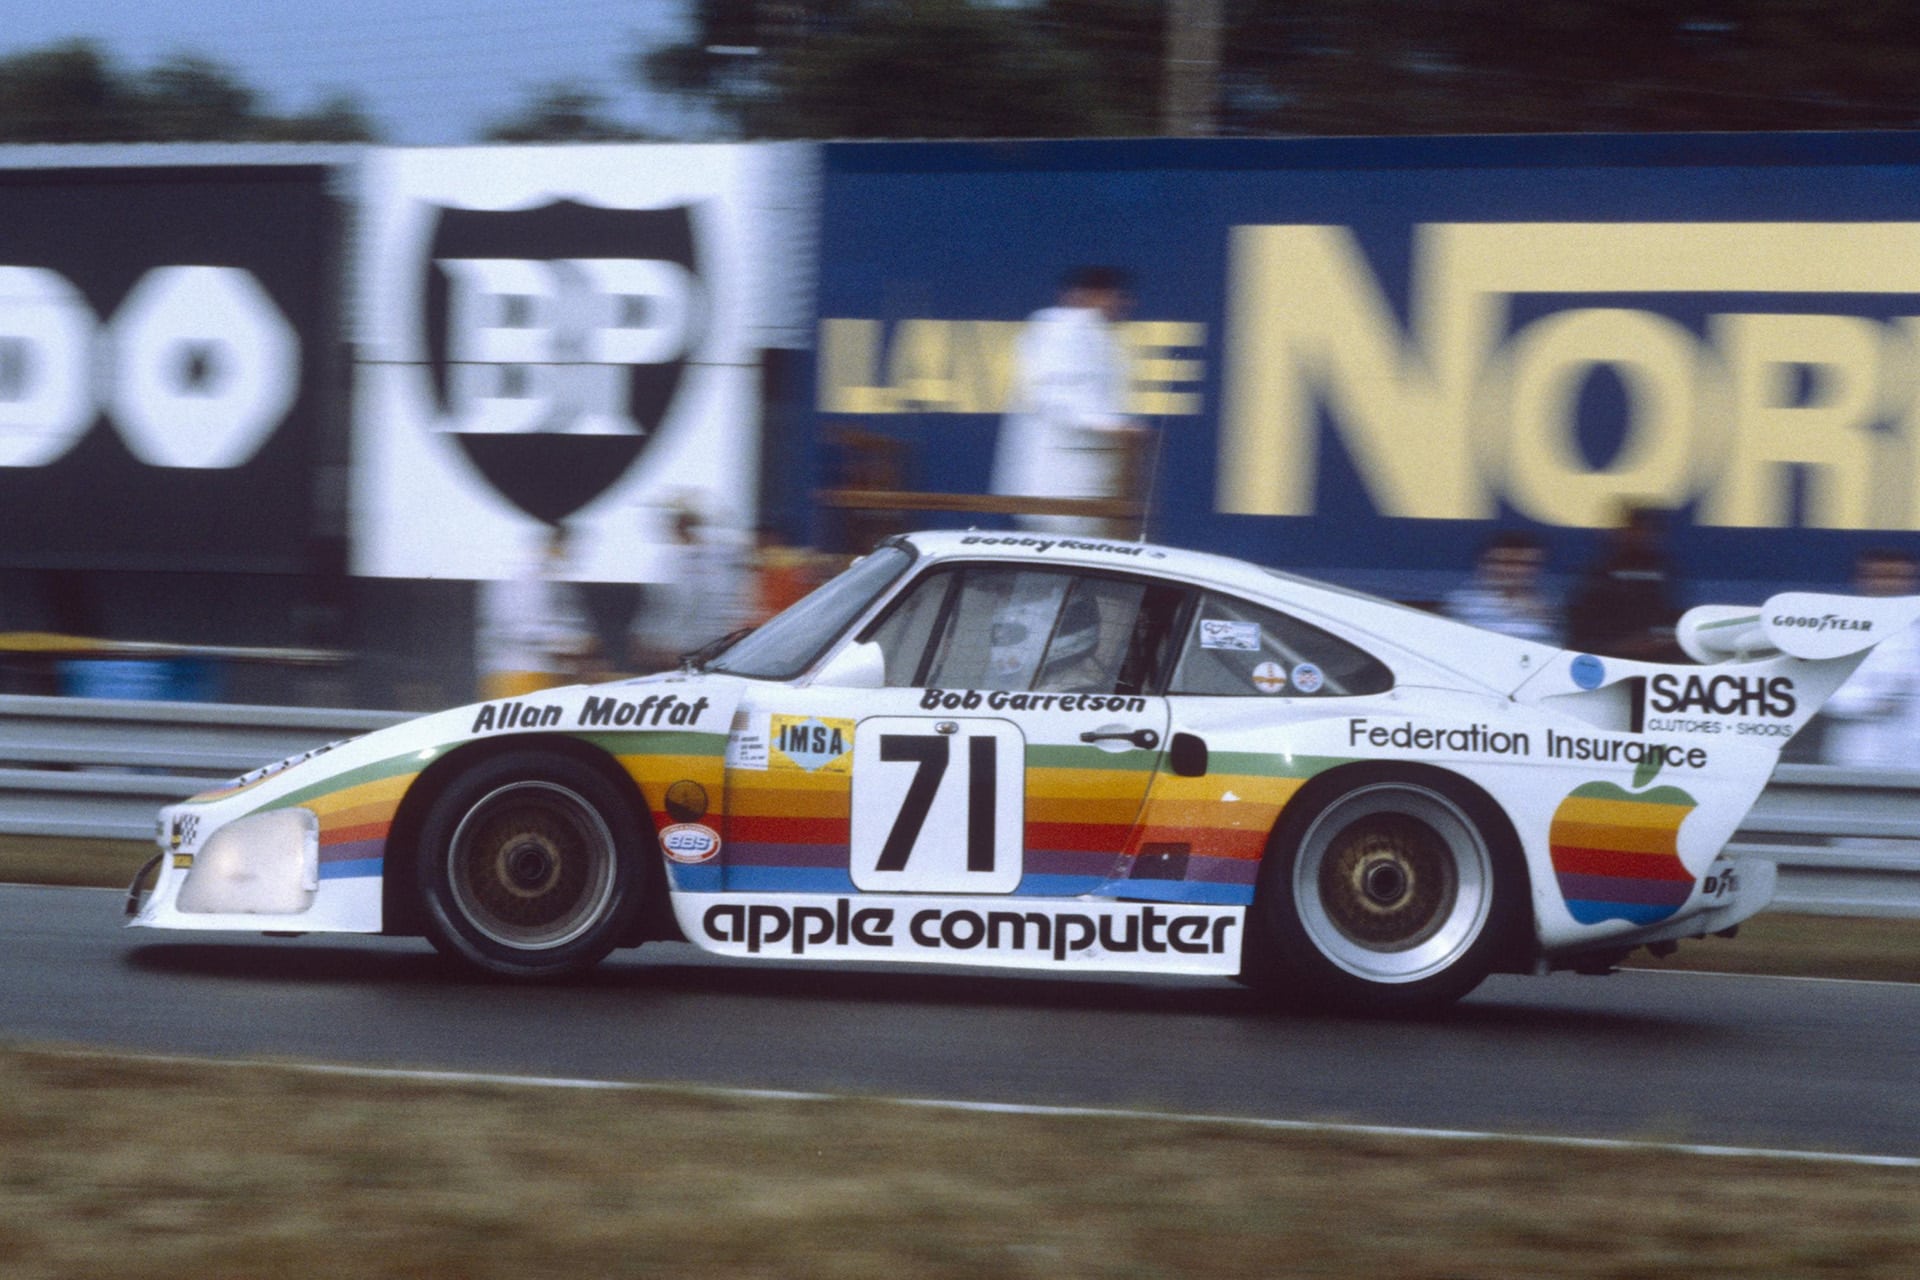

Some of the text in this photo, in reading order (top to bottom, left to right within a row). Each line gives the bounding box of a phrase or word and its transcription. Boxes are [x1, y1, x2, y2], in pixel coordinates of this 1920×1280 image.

[432, 258, 700, 436] BP
[1772, 614, 1873, 632] GOODYEAR
[472, 695, 709, 733] Allan Moffat
[919, 688, 1146, 712] Bob Garretson
[1651, 673, 1796, 718] SACHS
[780, 725, 843, 755] IMSA
[1349, 718, 1708, 769] Federation Insurance
[1648, 718, 1793, 737] CLUTCHES SHOCKS
[875, 734, 997, 873] 71
[703, 898, 1237, 961] apple computer
